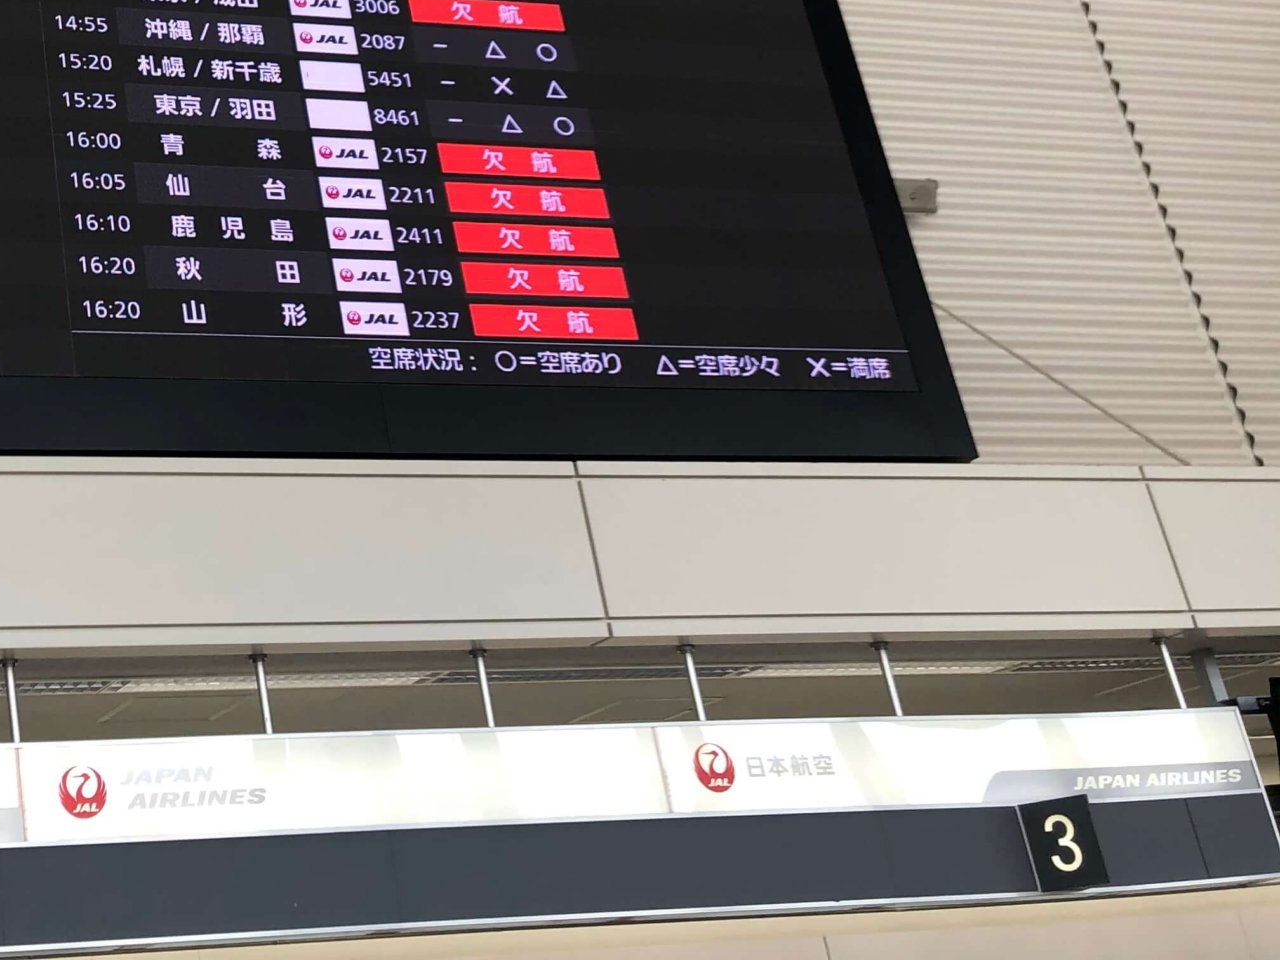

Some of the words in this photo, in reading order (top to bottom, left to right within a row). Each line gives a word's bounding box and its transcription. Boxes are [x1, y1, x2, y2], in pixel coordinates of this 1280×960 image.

[55, 15, 108, 32] 14:55
[315, 34, 349, 45] JAL
[360, 34, 405, 50] 2087
[59, 53, 112, 70] 15:20
[368, 71, 411, 87] 5451
[63, 92, 116, 109] 15:25
[374, 109, 419, 125] 8461
[67, 131, 121, 149] 16:00
[335, 148, 370, 160] JAL
[381, 147, 427, 164] 2157
[71, 172, 125, 190] 16:05
[342, 188, 377, 199] JAL
[389, 187, 434, 203] 2211
[75, 214, 130, 232] 16:10
[349, 229, 385, 241] JAL
[396, 227, 442, 244] 2411
[79, 256, 135, 274] 16:20
[356, 271, 392, 282] JAL
[404, 269, 452, 286] 2179
[83, 300, 140, 319] 16:20
[364, 313, 400, 325] JAL
[412, 311, 459, 328] 2237
[120, 766, 213, 785] JAPAN
[745, 754, 835, 777] 日本航空
[1074, 773, 1140, 790] JAPAN
[1146, 769, 1242, 787] AIRLINES
[708, 778, 731, 787] JAL
[73, 803, 99, 813] JAL
[128, 788, 266, 810] AIRLINES
[1044, 814, 1083, 872] 3
